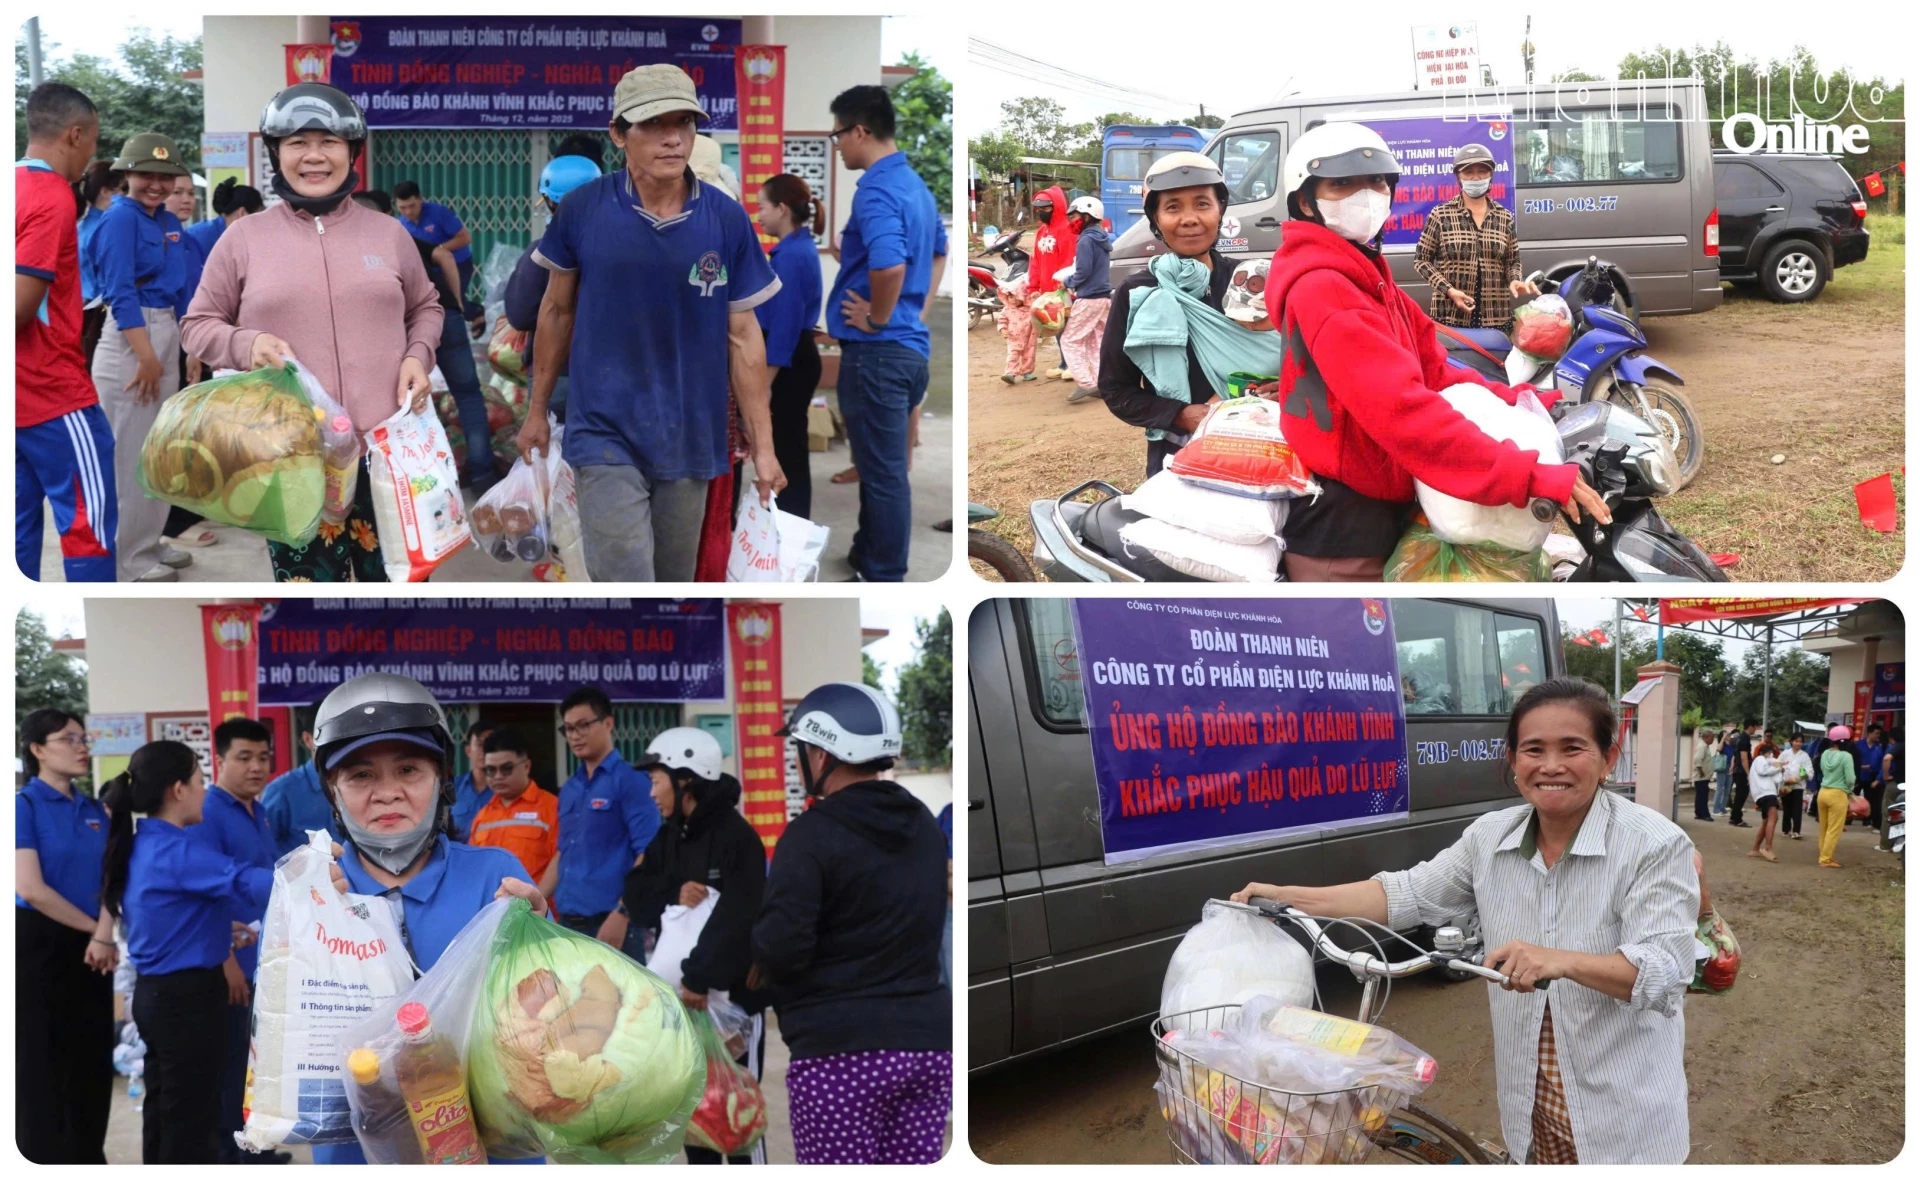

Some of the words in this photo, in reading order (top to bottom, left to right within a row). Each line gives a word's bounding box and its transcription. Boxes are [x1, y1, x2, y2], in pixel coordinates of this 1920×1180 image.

[388, 27, 416, 46] ĐOÀN
[418, 29, 450, 46] THANH
[452, 27, 476, 46] NIÊN
[477, 26, 504, 46] CÔNG
[506, 29, 519, 46] TY
[611, 27, 645, 48] KHÁNH
[351, 59, 393, 84] TÌNH
[456, 59, 526, 88] NGHIỆP
[412, 91, 439, 110] BÀO
[443, 91, 490, 110] KHÁNH
[492, 92, 525, 111] VĨNH
[568, 94, 605, 114] PHỤC
[480, 114, 509, 124] Tháng
[551, 114, 573, 123] 2025
[1405, 147, 1435, 159] THANH
[1413, 162, 1435, 178] ĐIỆN
[1437, 163, 1454, 177] LỰC
[1413, 182, 1435, 202] BÀO
[1524, 198, 1555, 214] 79B
[1565, 195, 1618, 212] 002.77
[1401, 210, 1424, 234] HẬU
[1126, 600, 1153, 611] CÔNG
[1154, 603, 1166, 612] TY
[1204, 608, 1223, 619] ĐIỆN
[1224, 610, 1240, 621] LỰC
[1241, 612, 1266, 623] KHÁNH
[1267, 614, 1283, 624] HÒA
[269, 625, 320, 654] TÌNH
[393, 623, 474, 657] NGHIỆP
[496, 624, 562, 652] NGHĨA
[632, 624, 675, 652] BÀO
[1189, 626, 1238, 653] ĐOÀN
[1240, 633, 1293, 656] THANH
[1294, 634, 1330, 659] NIÊN
[270, 661, 292, 687] HỘ
[437, 661, 474, 682] VĨNH
[524, 664, 565, 685] PHỤC
[569, 659, 599, 684] HẬU
[602, 658, 633, 683] QUẢ
[636, 664, 658, 682] DO
[661, 661, 681, 682] LŨ
[683, 663, 709, 685] LỤT
[1093, 656, 1150, 686] CÔNG
[1153, 663, 1175, 686] TY
[1181, 657, 1205, 687] CỔ
[1209, 659, 1255, 688] PHẦN
[1258, 664, 1294, 693] ĐIỆN
[1297, 667, 1324, 693] LỰC
[1326, 667, 1370, 692] KHÁNH
[805, 718, 838, 742] 78win
[1109, 699, 1162, 752] ỦNG
[1166, 704, 1198, 756] HỘ
[1202, 700, 1258, 747] ĐỒNG
[1261, 704, 1299, 745] BÀO
[1302, 704, 1358, 743] KHÁNH
[1360, 706, 1395, 741] VĨNH
[1416, 741, 1449, 765] 79B
[1460, 738, 1507, 762] 002.77
[1119, 763, 1183, 818] KHẮC
[1186, 771, 1242, 814] PHỤC
[1247, 762, 1284, 809] HẬU
[1288, 755, 1323, 802] QUẢ
[1325, 763, 1348, 795] DO
[1351, 757, 1370, 793] LŨ
[1372, 761, 1397, 796] LỤT
[309, 1002, 333, 1012] Thông
[334, 1003, 344, 1011] tin
[308, 1063, 333, 1072] Hướng
